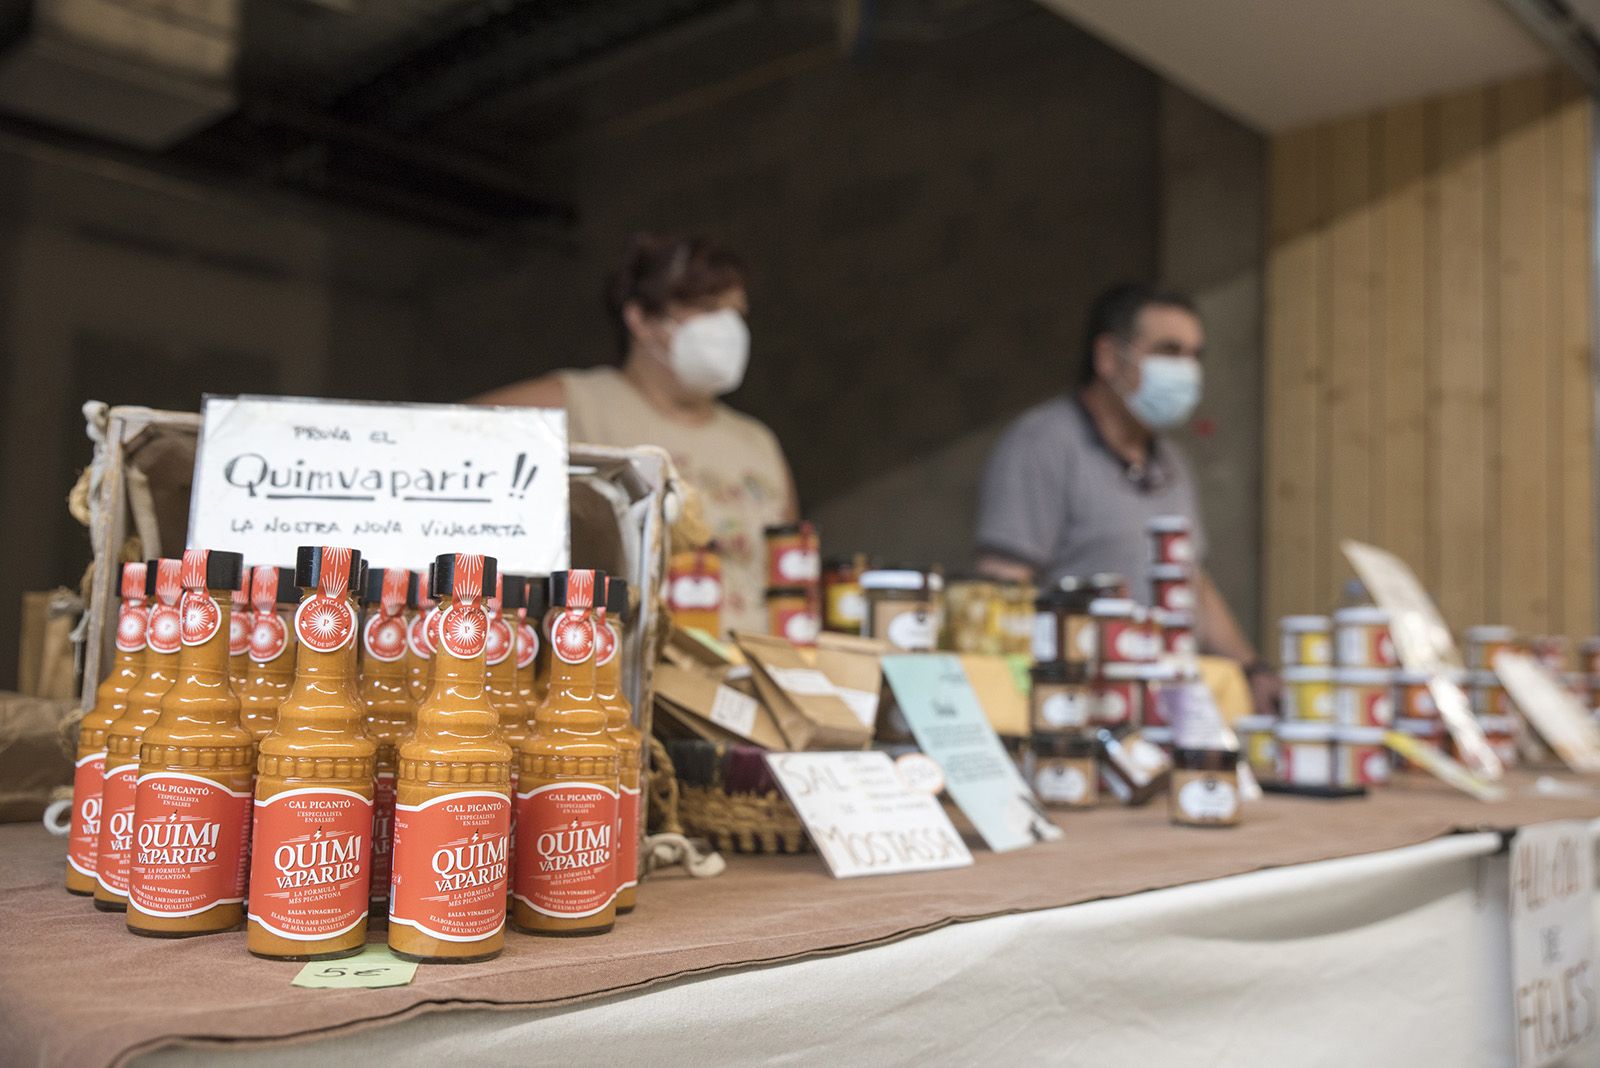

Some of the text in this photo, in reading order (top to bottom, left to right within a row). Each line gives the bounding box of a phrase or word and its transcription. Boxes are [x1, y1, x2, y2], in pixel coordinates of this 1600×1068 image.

[369, 431, 397, 444] EL
[231, 518, 254, 533] LA
[354, 519, 402, 535] NOVA
[779, 755, 850, 796] SAL
[151, 782, 209, 796] CAL PICANTÓ
[548, 792, 602, 801] CAL PICANTÓ
[289, 799, 350, 809] CAL PICANTÓ
[446, 801, 502, 812] CAL PICANTÓ
[809, 823, 967, 870] MOSTASSA
[157, 886, 190, 895] VINAGRETA
[303, 891, 341, 903] PICANTONA
[271, 911, 304, 925] ELABORADA
[429, 915, 464, 927] ELABORADA
